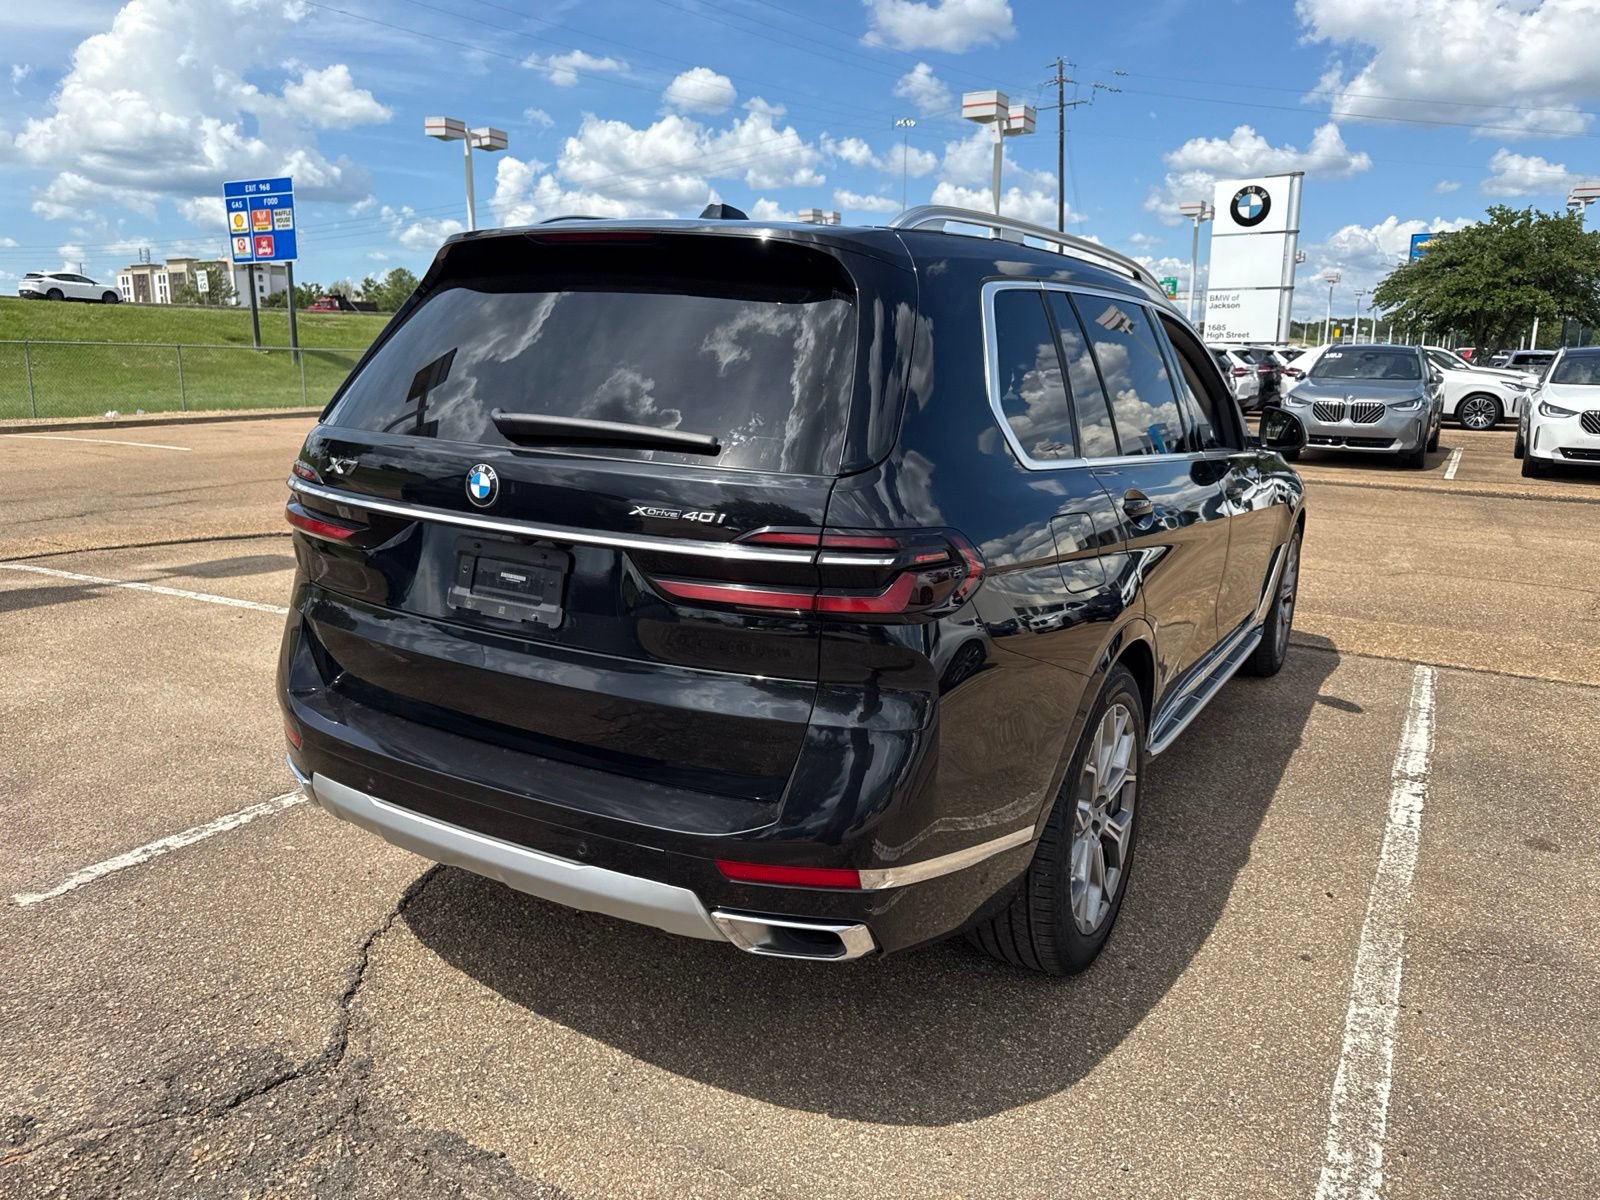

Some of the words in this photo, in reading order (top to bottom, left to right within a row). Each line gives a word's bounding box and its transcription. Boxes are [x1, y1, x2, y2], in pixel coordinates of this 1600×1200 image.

[245, 184, 256, 192] EXIT
[231, 201, 243, 209] GAS
[263, 197, 278, 206] FOOD
[1209, 294, 1230, 302] BMW
[1206, 332, 1225, 340] High
[1225, 331, 1250, 339] Street
[325, 457, 359, 476] X7
